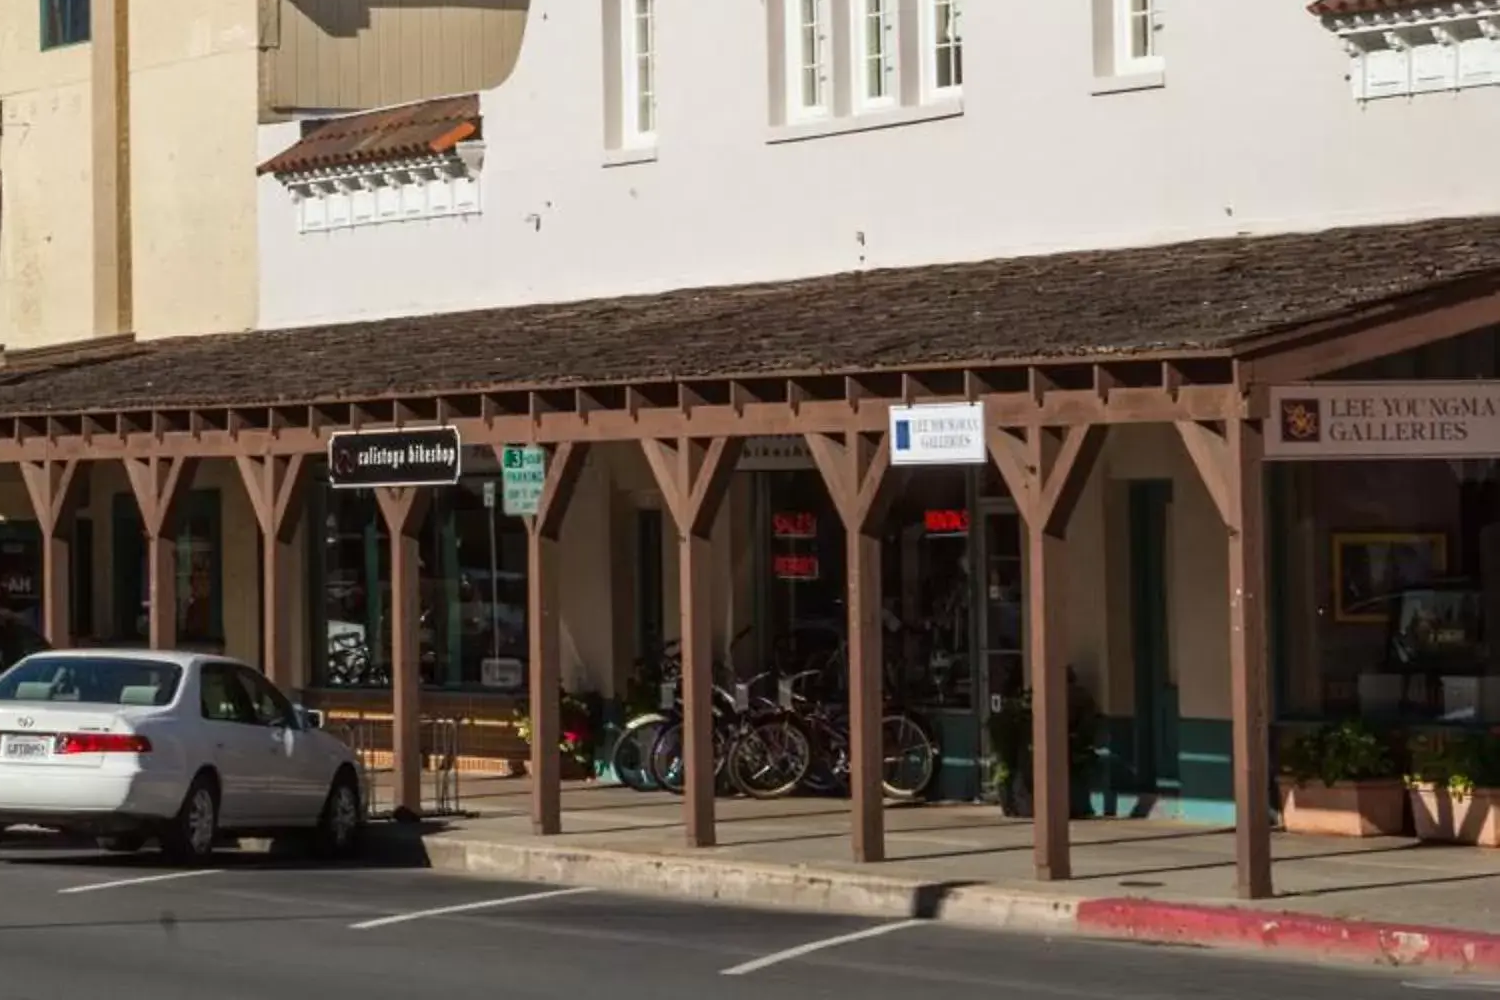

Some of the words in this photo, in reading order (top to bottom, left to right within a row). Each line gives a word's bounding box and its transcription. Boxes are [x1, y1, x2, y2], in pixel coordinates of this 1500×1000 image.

[1331, 398, 1375, 417] LEE
[1383, 397, 1499, 417] YOUNGMA
[1329, 421, 1469, 440] GALLERIES
[358, 445, 405, 468] calistoga
[408, 442, 454, 466] bikeshop
[743, 445, 812, 458] bikesho
